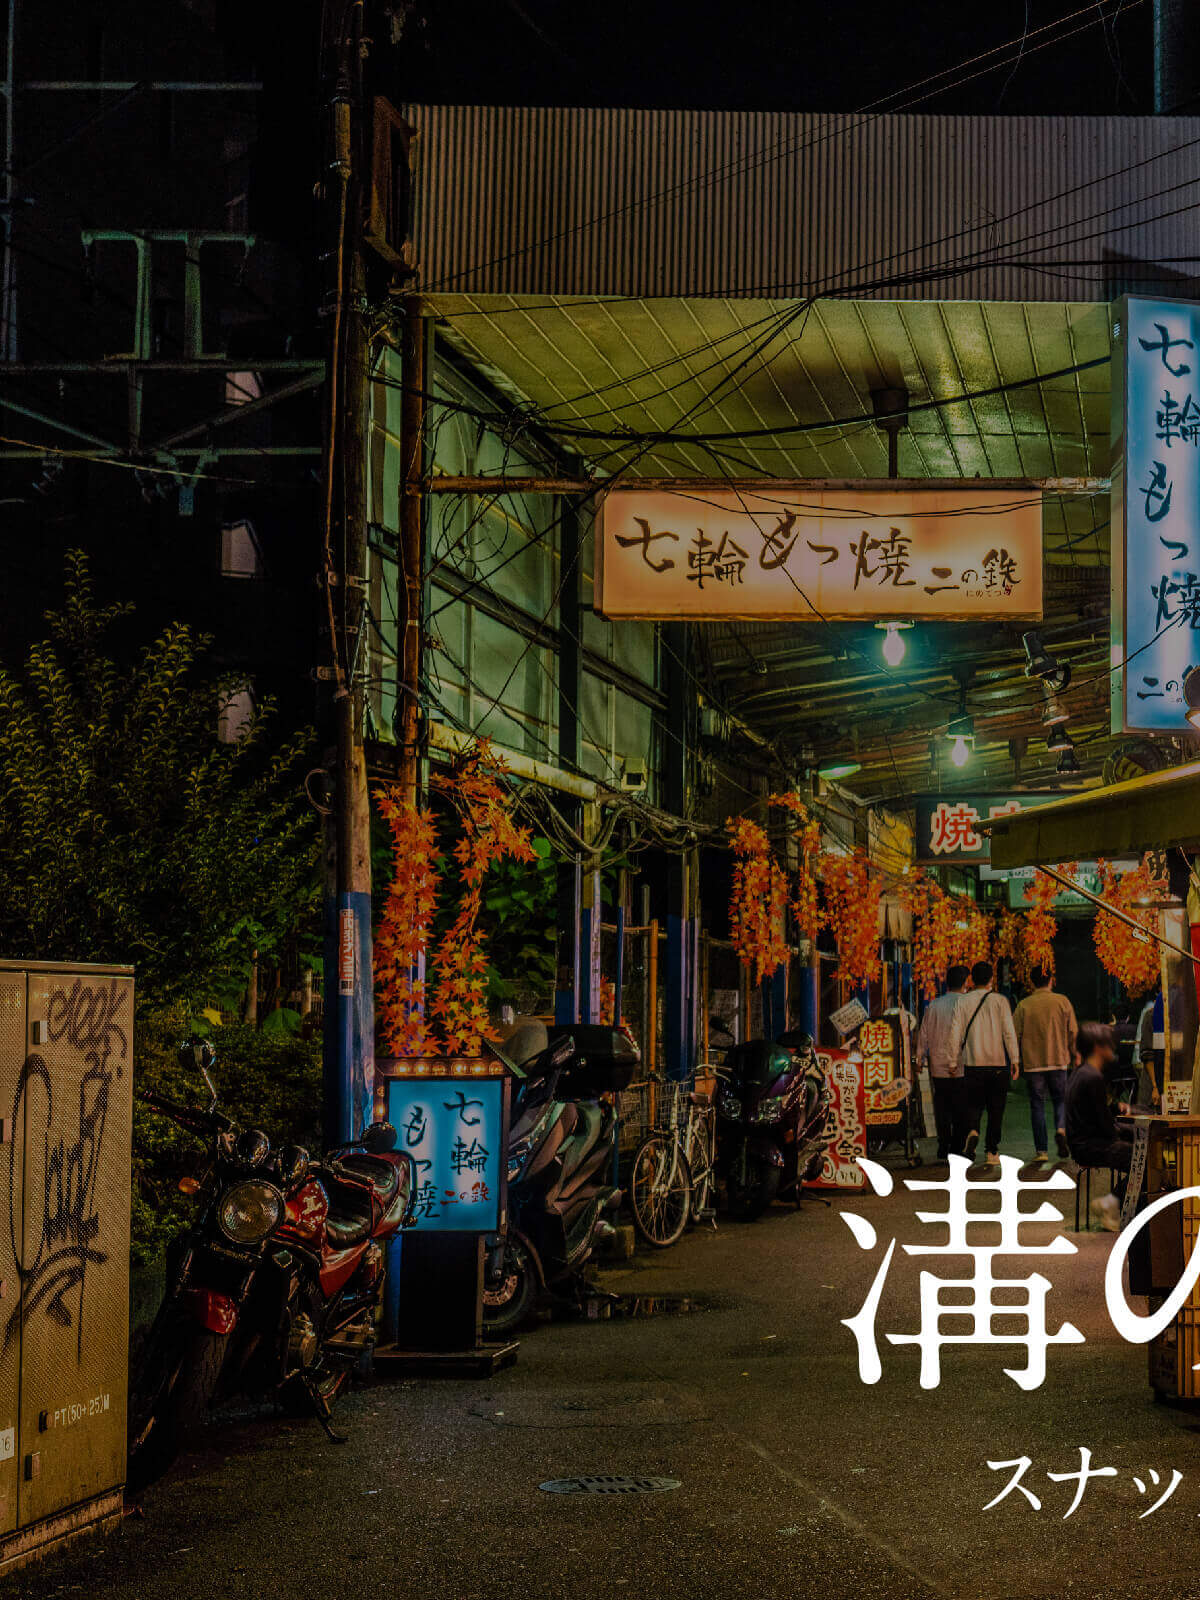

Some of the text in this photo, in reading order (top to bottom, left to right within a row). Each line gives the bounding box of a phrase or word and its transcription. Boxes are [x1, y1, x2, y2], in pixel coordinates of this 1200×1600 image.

[615, 509, 916, 590] 七輪もつ焼
[444, 1091, 490, 1175] 七輪
